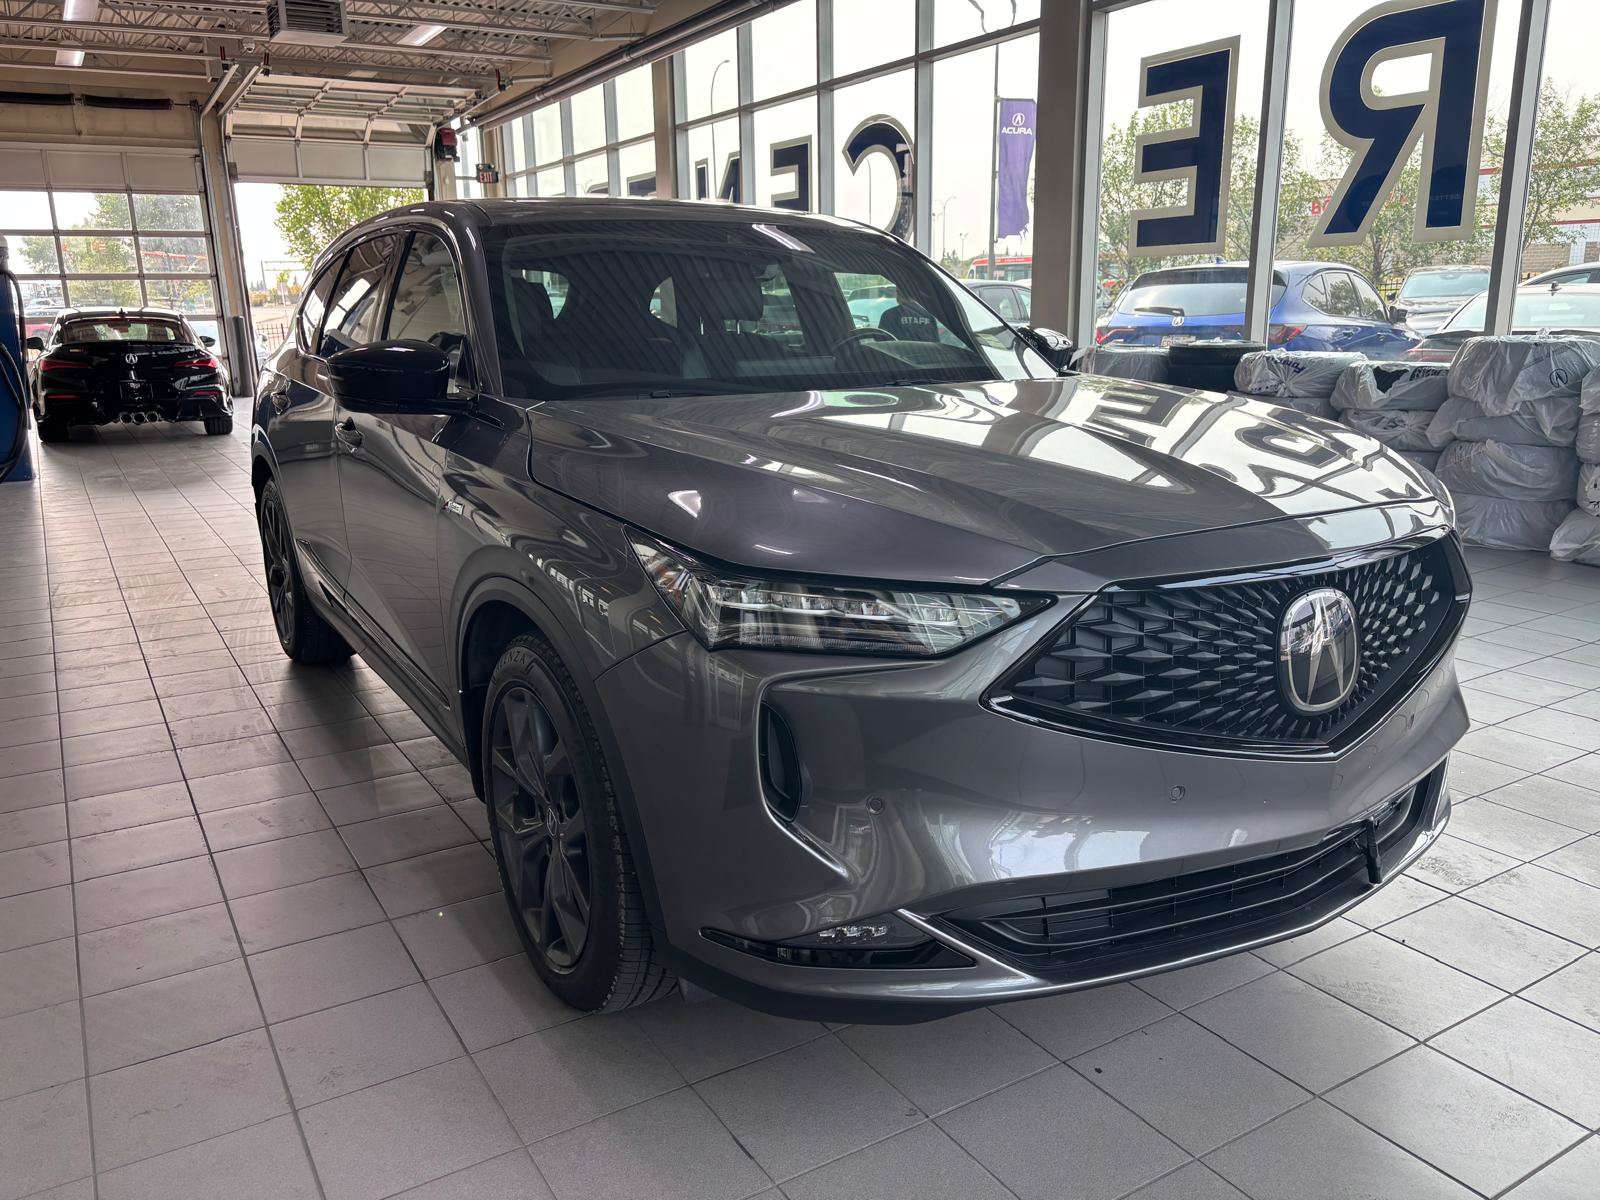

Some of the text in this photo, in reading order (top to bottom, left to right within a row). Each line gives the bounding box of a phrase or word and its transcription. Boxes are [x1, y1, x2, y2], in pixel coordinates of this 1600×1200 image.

[1001, 126, 1033, 136] ACURA
[480, 171, 493, 183] EXIT
[900, 316, 930, 325] STAFF
